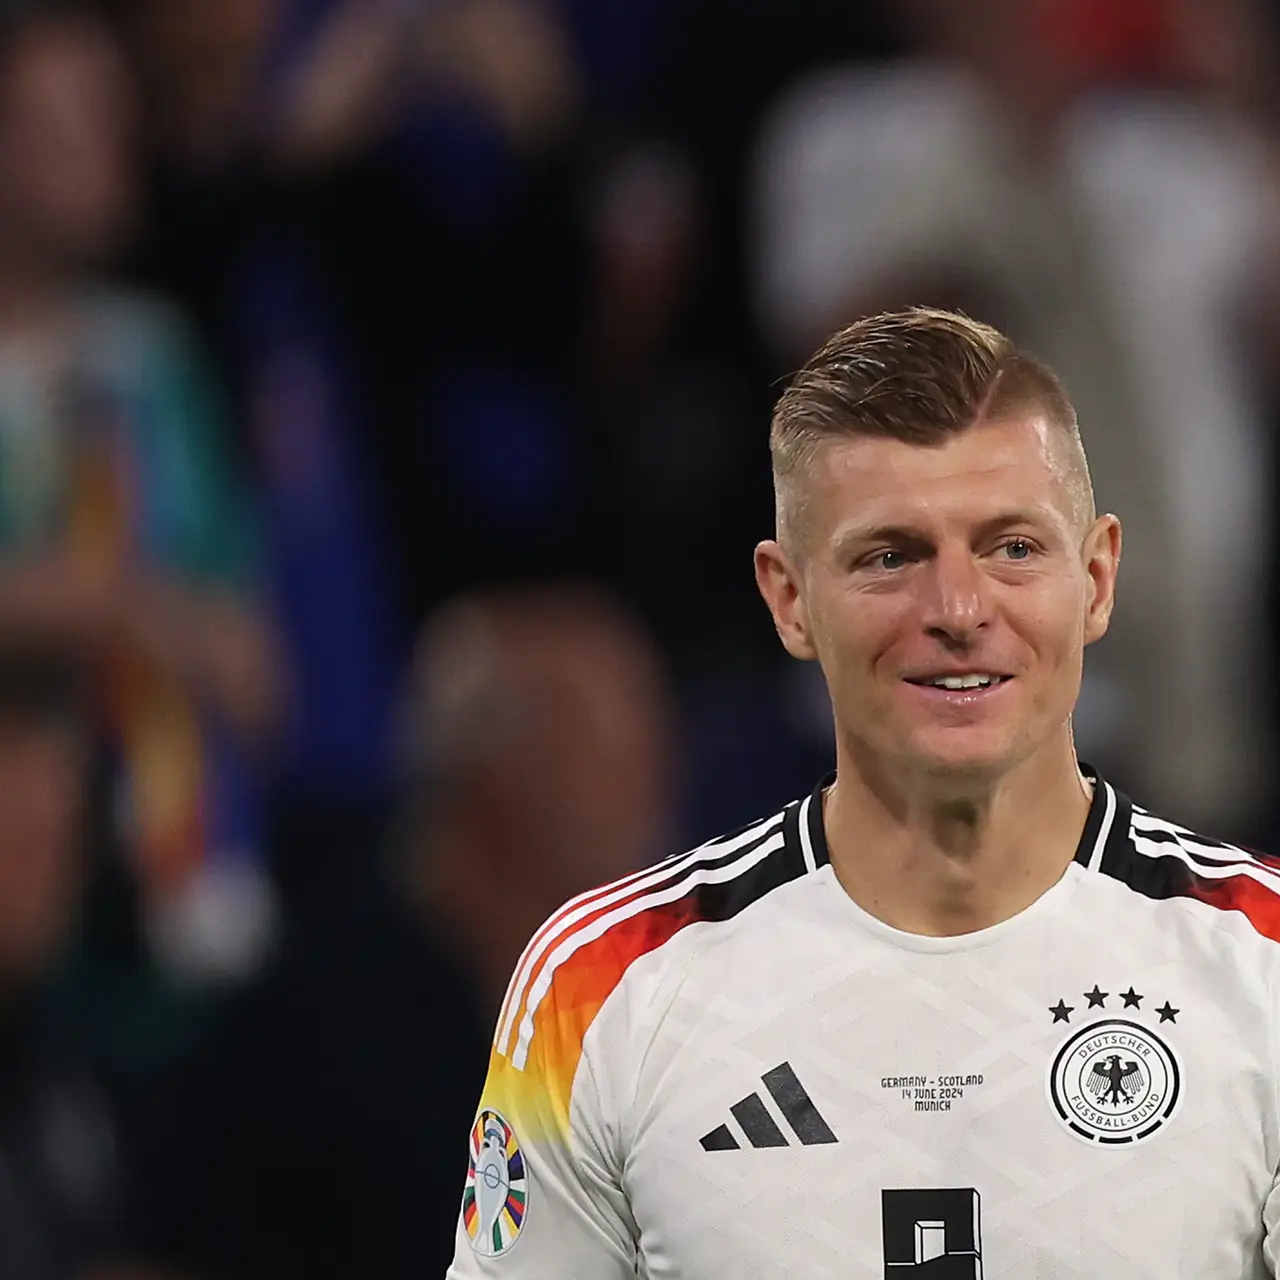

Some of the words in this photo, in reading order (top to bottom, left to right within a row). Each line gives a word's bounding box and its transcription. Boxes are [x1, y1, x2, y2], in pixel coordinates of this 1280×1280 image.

[1077, 1035, 1152, 1059] DEUTSCHER
[881, 1076, 927, 1088] GERMANY
[938, 1074, 984, 1087] SCOTLAND
[902, 1089, 911, 1099] 14
[914, 1088, 937, 1099] JUNE
[939, 1088, 963, 1099] 2024
[914, 1100, 951, 1111] MUNICH
[1070, 1092, 1160, 1127] FUSSBALL-BUND
